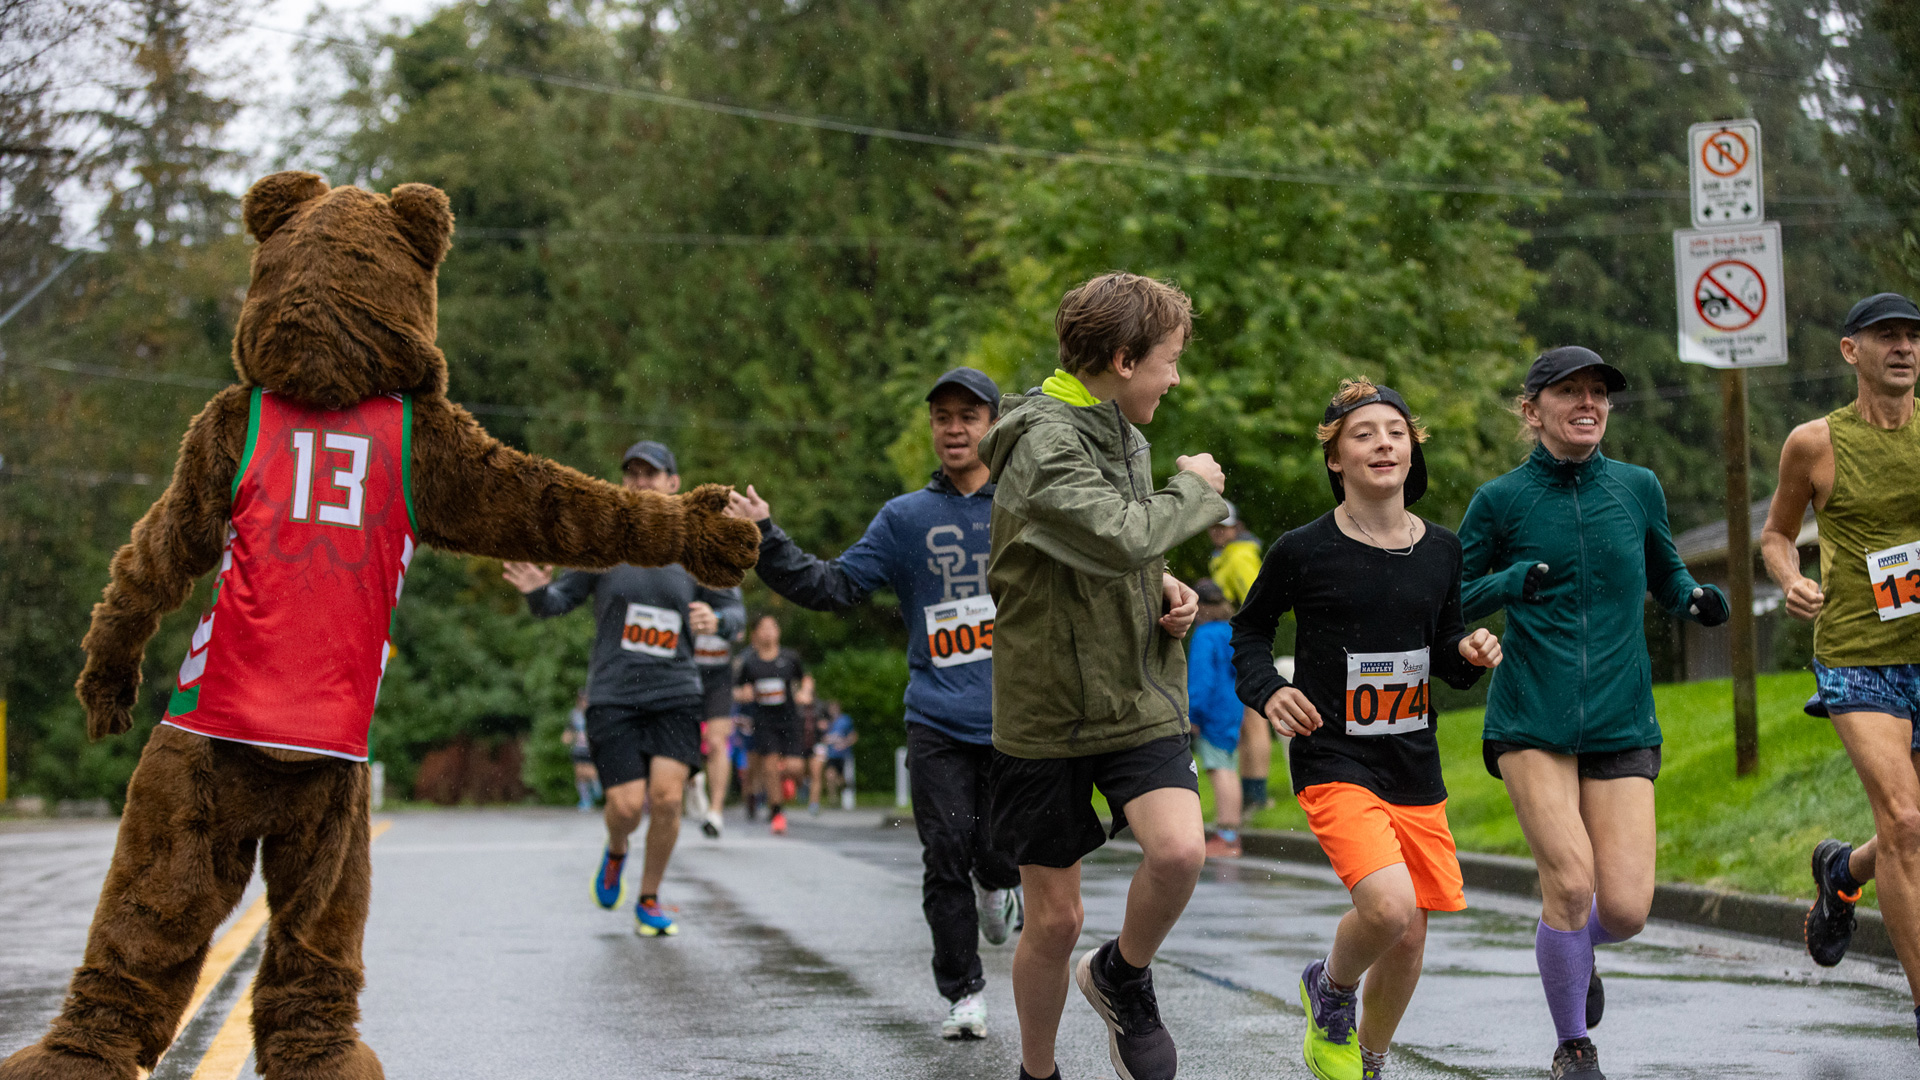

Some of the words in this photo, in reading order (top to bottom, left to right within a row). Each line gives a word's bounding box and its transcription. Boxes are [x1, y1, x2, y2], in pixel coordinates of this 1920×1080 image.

[289, 428, 373, 531] 13
[628, 624, 674, 649] 002
[934, 619, 994, 658] 005
[1353, 678, 1426, 726] 074
